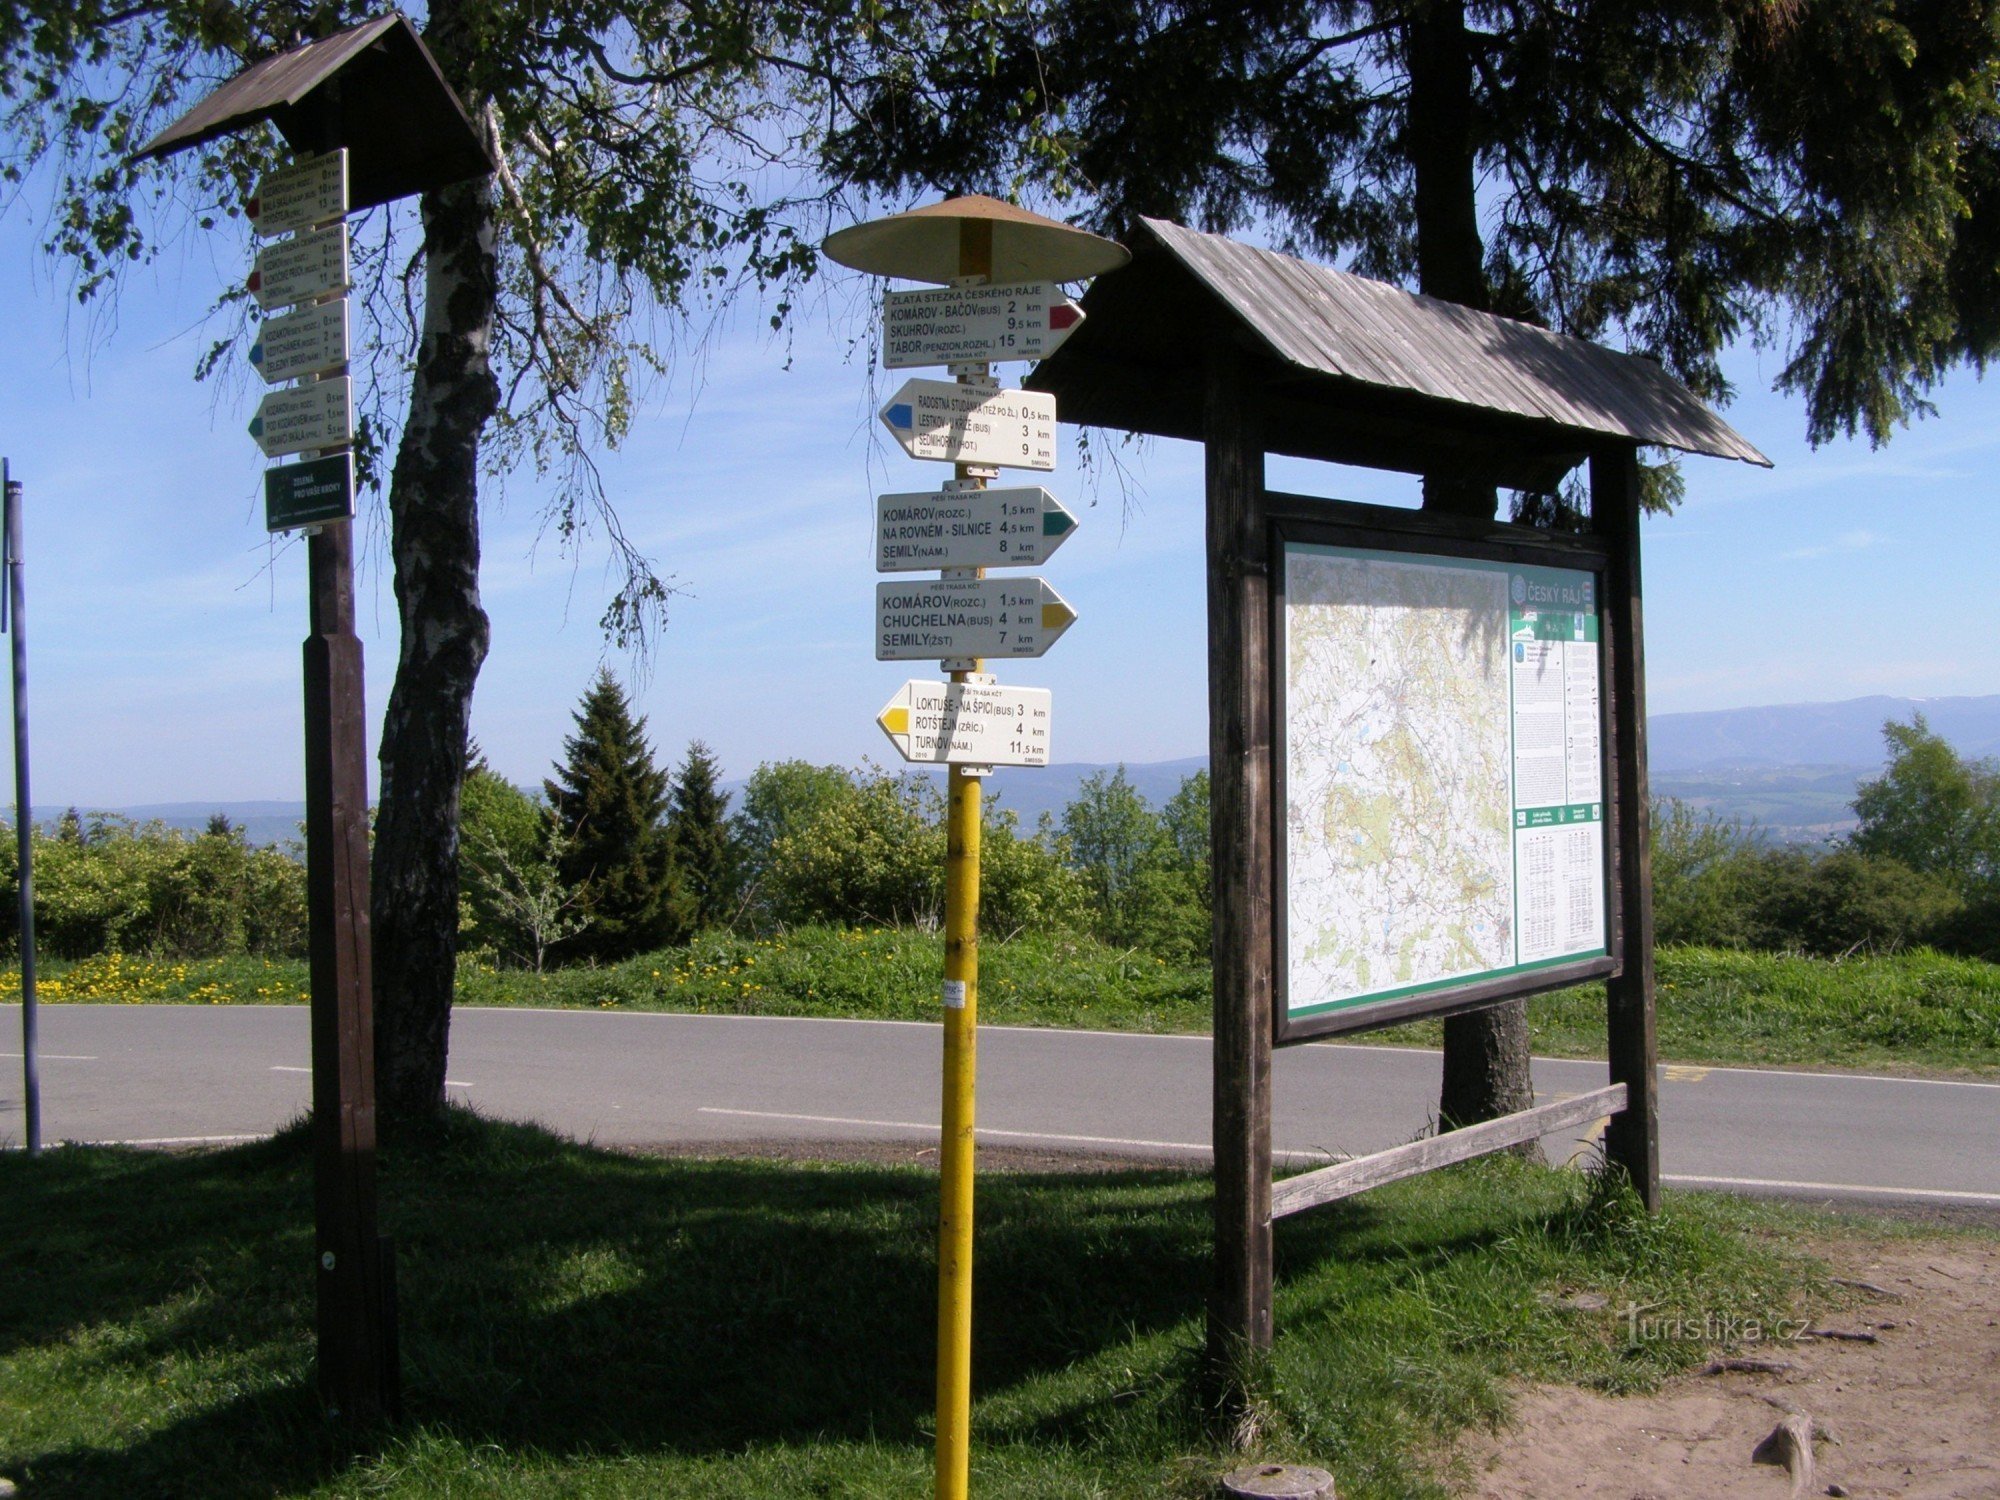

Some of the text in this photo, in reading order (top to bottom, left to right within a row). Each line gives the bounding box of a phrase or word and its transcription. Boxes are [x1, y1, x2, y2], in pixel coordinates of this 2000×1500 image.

[891, 286, 1041, 305] ZLATÁ STEZKA ČESKÉHO RÁJE
[890, 303, 937, 321] KOMÁROV
[1008, 301, 1016, 313] 2
[1026, 303, 1041, 313] km
[1008, 318, 1024, 330] 9,5
[1026, 319, 1041, 329] km
[999, 334, 1015, 347] 15
[1026, 336, 1041, 345] km
[919, 395, 950, 410] RADOSTNÁ
[997, 407, 1007, 416] PO
[1022, 406, 1035, 420] 0,5
[1037, 411, 1050, 420] km
[972, 423, 990, 435] (BUS)
[1022, 425, 1029, 437] 3
[1037, 429, 1050, 439] km
[1022, 444, 1029, 456] 9
[1037, 448, 1050, 458] km
[1001, 503, 1017, 516] 1,5
[1020, 504, 1035, 514] km
[883, 528, 897, 540] NA
[899, 524, 943, 538] ROVNÉM
[952, 522, 991, 536] SILNICE
[1000, 521, 1017, 534] 4,5
[1020, 524, 1034, 533] km
[1000, 540, 1007, 553] 8
[1019, 543, 1034, 552] km
[1528, 581, 1559, 602] ČESKÝ
[1000, 593, 1017, 606] 1,5
[1019, 597, 1034, 605] km
[999, 612, 1007, 625] 4
[1018, 615, 1033, 624] km
[999, 631, 1007, 644] 7
[1018, 634, 1033, 643] km
[916, 697, 953, 712] LOKTUŠE
[959, 701, 971, 714] NA
[1017, 704, 1024, 716] 3
[1034, 708, 1045, 718] km
[1016, 723, 1023, 735] 4
[1032, 727, 1044, 737] km
[1009, 740, 1030, 754] 11,5
[1032, 744, 1044, 755] km
